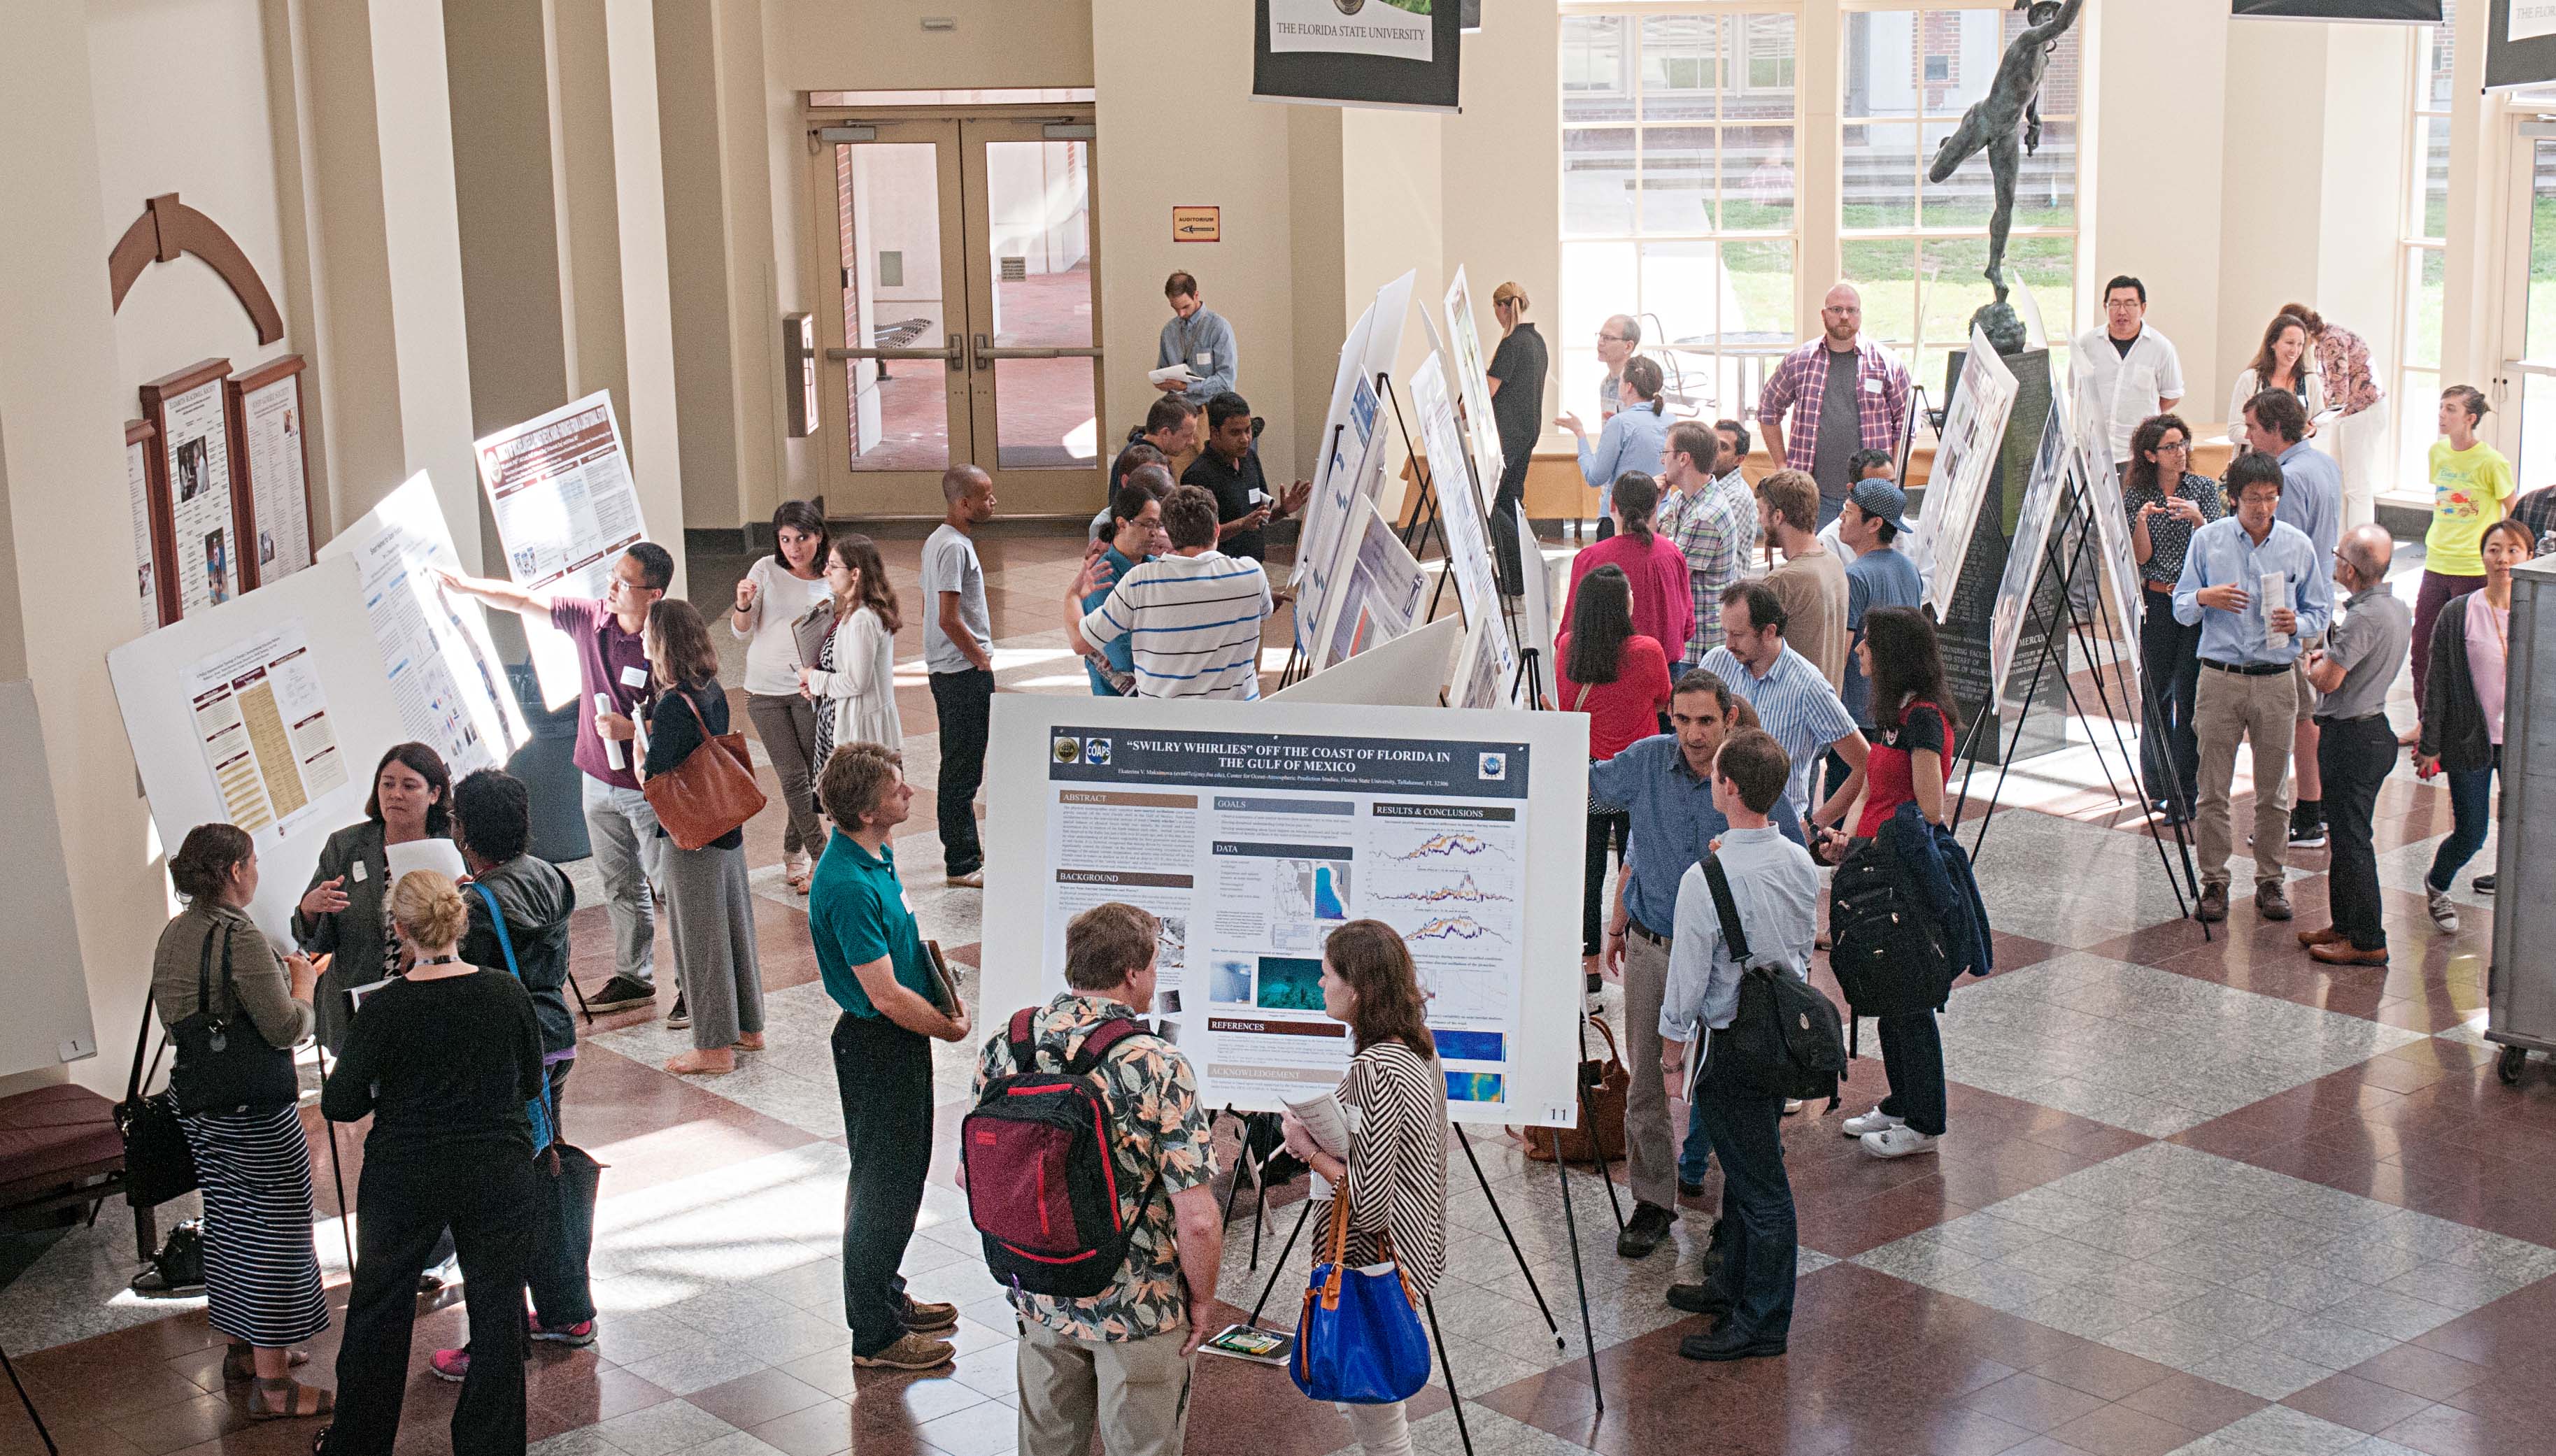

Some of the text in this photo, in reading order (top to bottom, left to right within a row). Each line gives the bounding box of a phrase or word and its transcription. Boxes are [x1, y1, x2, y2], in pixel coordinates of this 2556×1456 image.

[2516, 7, 2533, 20] THE
[1276, 22, 1426, 41] THE FLORIDA STATE UNIVERSITY
[2019, 632, 2050, 647] MERCU
[1086, 745, 1110, 756] COAPS
[1126, 741, 1451, 762] “SWILRY WHIRLIES” OFF THE COAST OF FLORIDA IN
[1219, 757, 1356, 773] THE GULF OF MEXICO
[1483, 762, 1500, 770] NSF
[1063, 794, 1107, 802] ABSTRACT
[1218, 800, 1246, 808] GOALS
[1376, 806, 1412, 815] RESULTS
[1423, 808, 1484, 818] CONCLUSIONS
[1060, 873, 1119, 883] BACKGROUND
[1212, 1020, 1265, 1031] REFERENCES
[71, 1040, 79, 1051] 1
[1212, 1067, 1300, 1079] ACKNOWLEDGEMENT
[1550, 1108, 1568, 1121] 11
